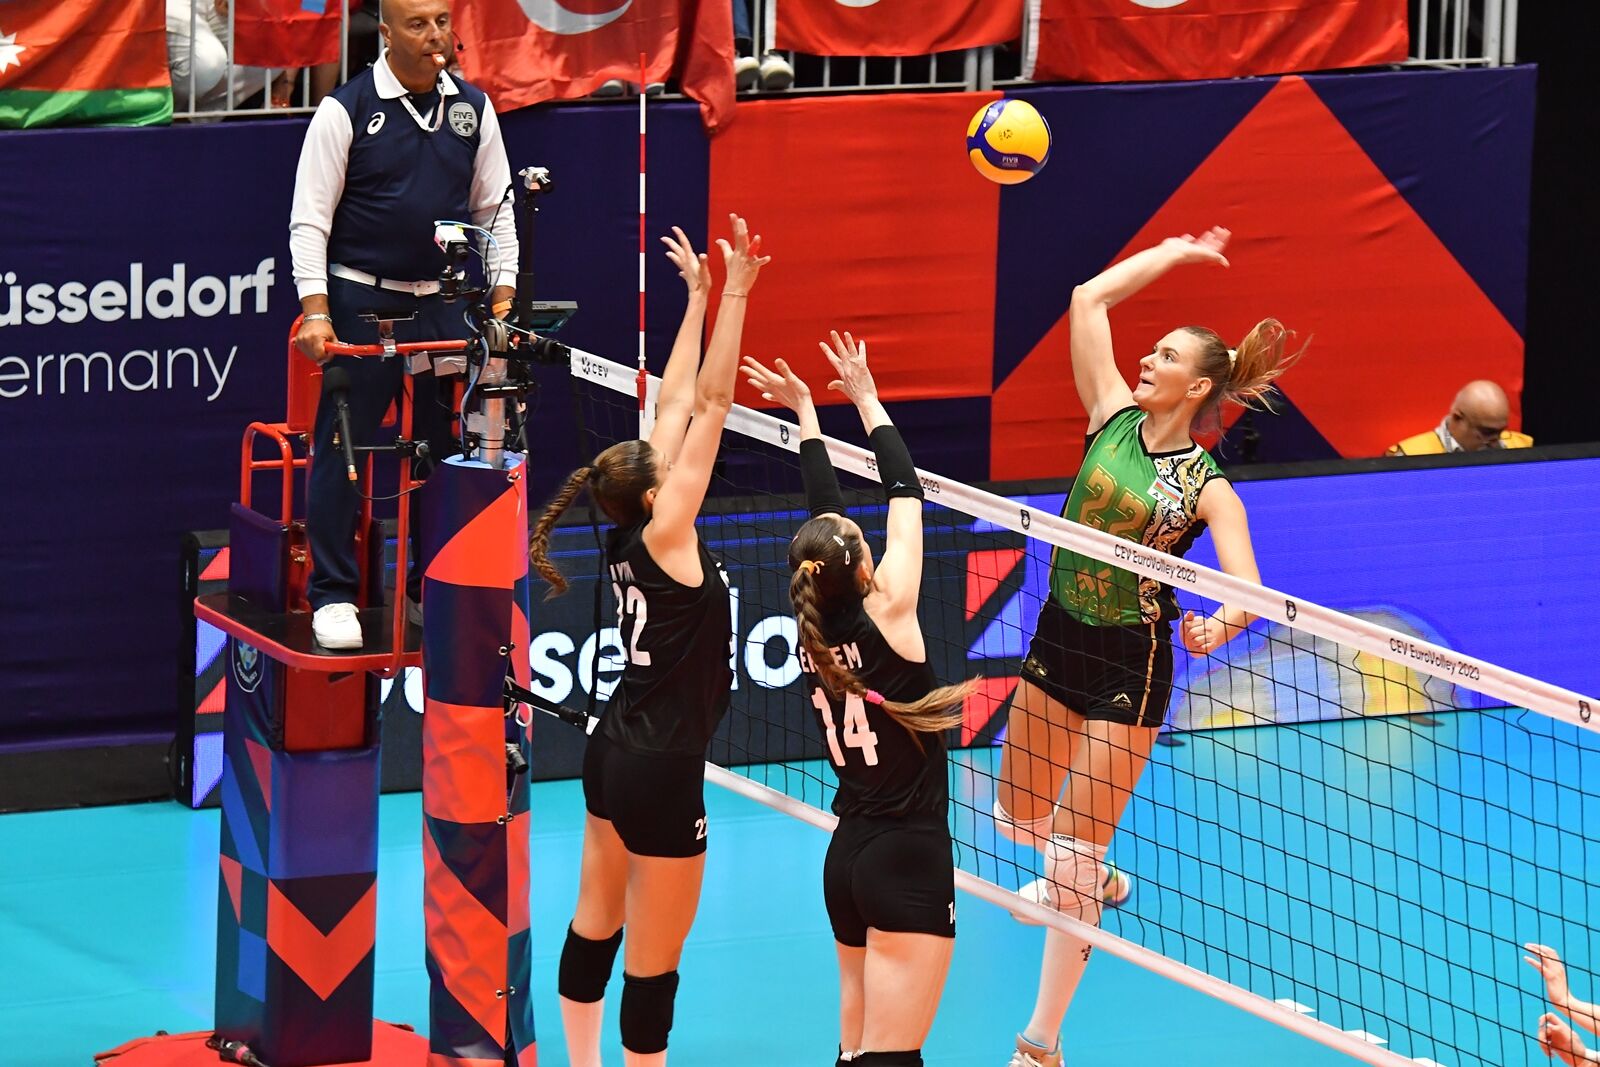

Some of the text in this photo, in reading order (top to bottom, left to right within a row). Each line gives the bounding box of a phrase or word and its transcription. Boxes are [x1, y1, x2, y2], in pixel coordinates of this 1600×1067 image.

[0, 257, 275, 327] üsseldorf
[0, 345, 238, 401] ermany
[591, 364, 609, 378] CEV
[866, 456, 940, 493] CE 2023
[1079, 463, 1150, 542] 22
[1152, 491, 1173, 507] AZE
[1114, 543, 1197, 584] CEV EuroVolley 2023
[800, 641, 863, 673] EEM
[1389, 637, 1480, 681] CEV EuroVolley 2023
[811, 687, 878, 766] 14
[695, 816, 707, 840] 2
[948, 901, 955, 924] 1
